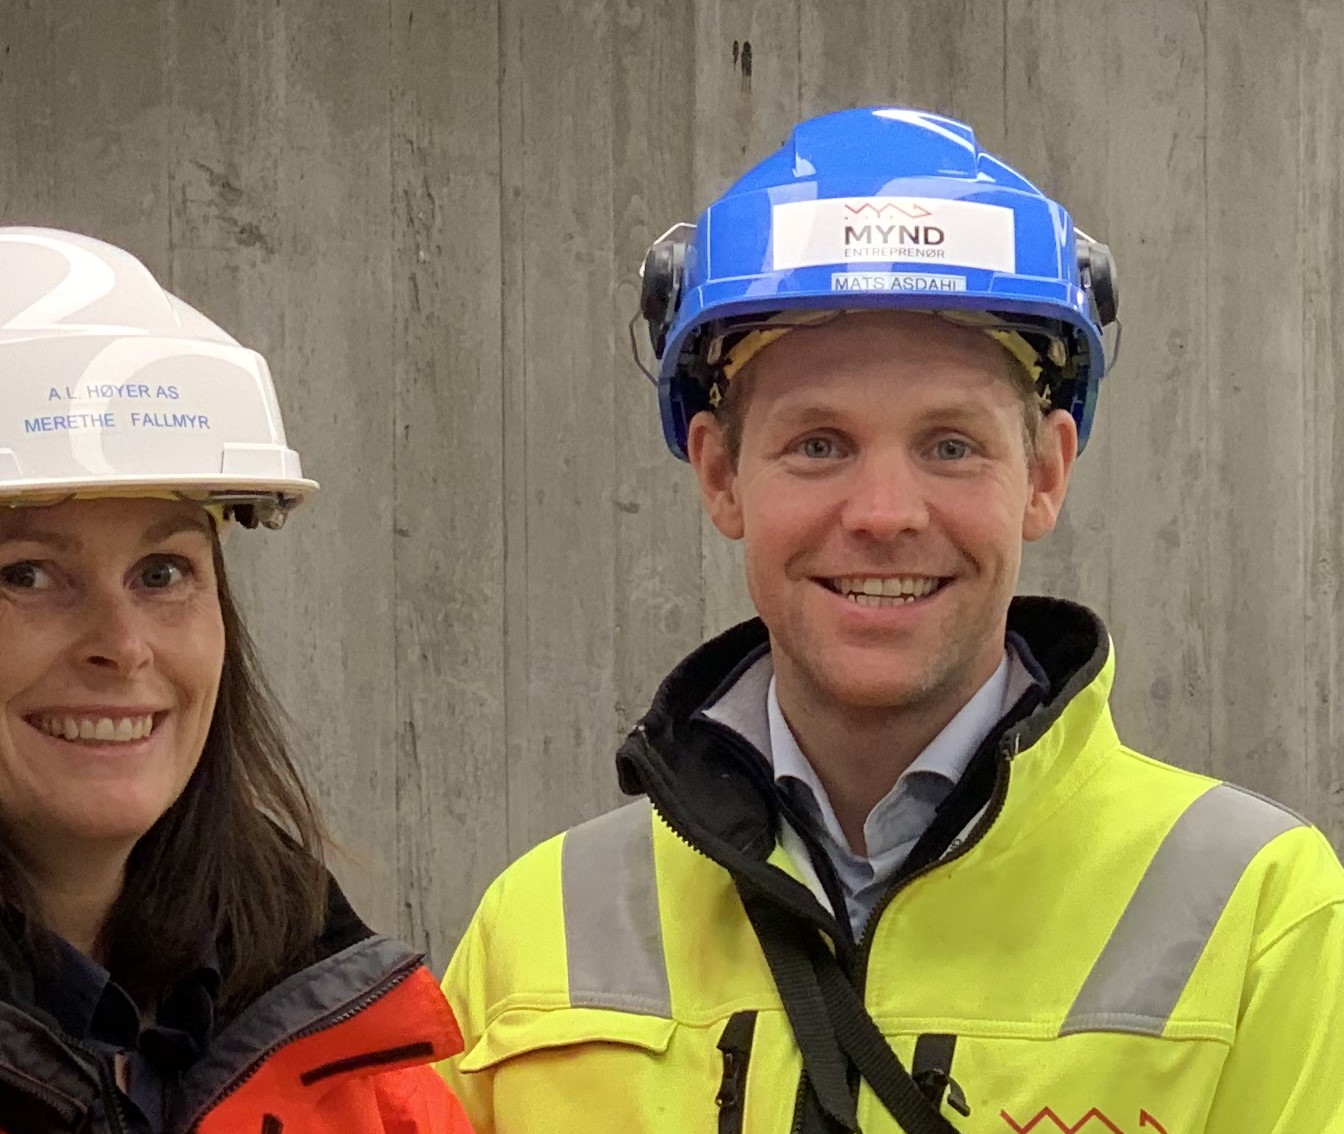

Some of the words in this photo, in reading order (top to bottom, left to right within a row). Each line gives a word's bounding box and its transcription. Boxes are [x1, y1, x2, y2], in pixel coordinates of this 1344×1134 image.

[844, 224, 945, 246] MYND
[844, 248, 945, 258] ENTREPRENØR
[835, 276, 885, 290] MATS
[87, 384, 151, 399] HØYER
[156, 385, 180, 399] AS
[24, 413, 115, 433] MERETHE
[131, 412, 211, 430] FALLMYR
